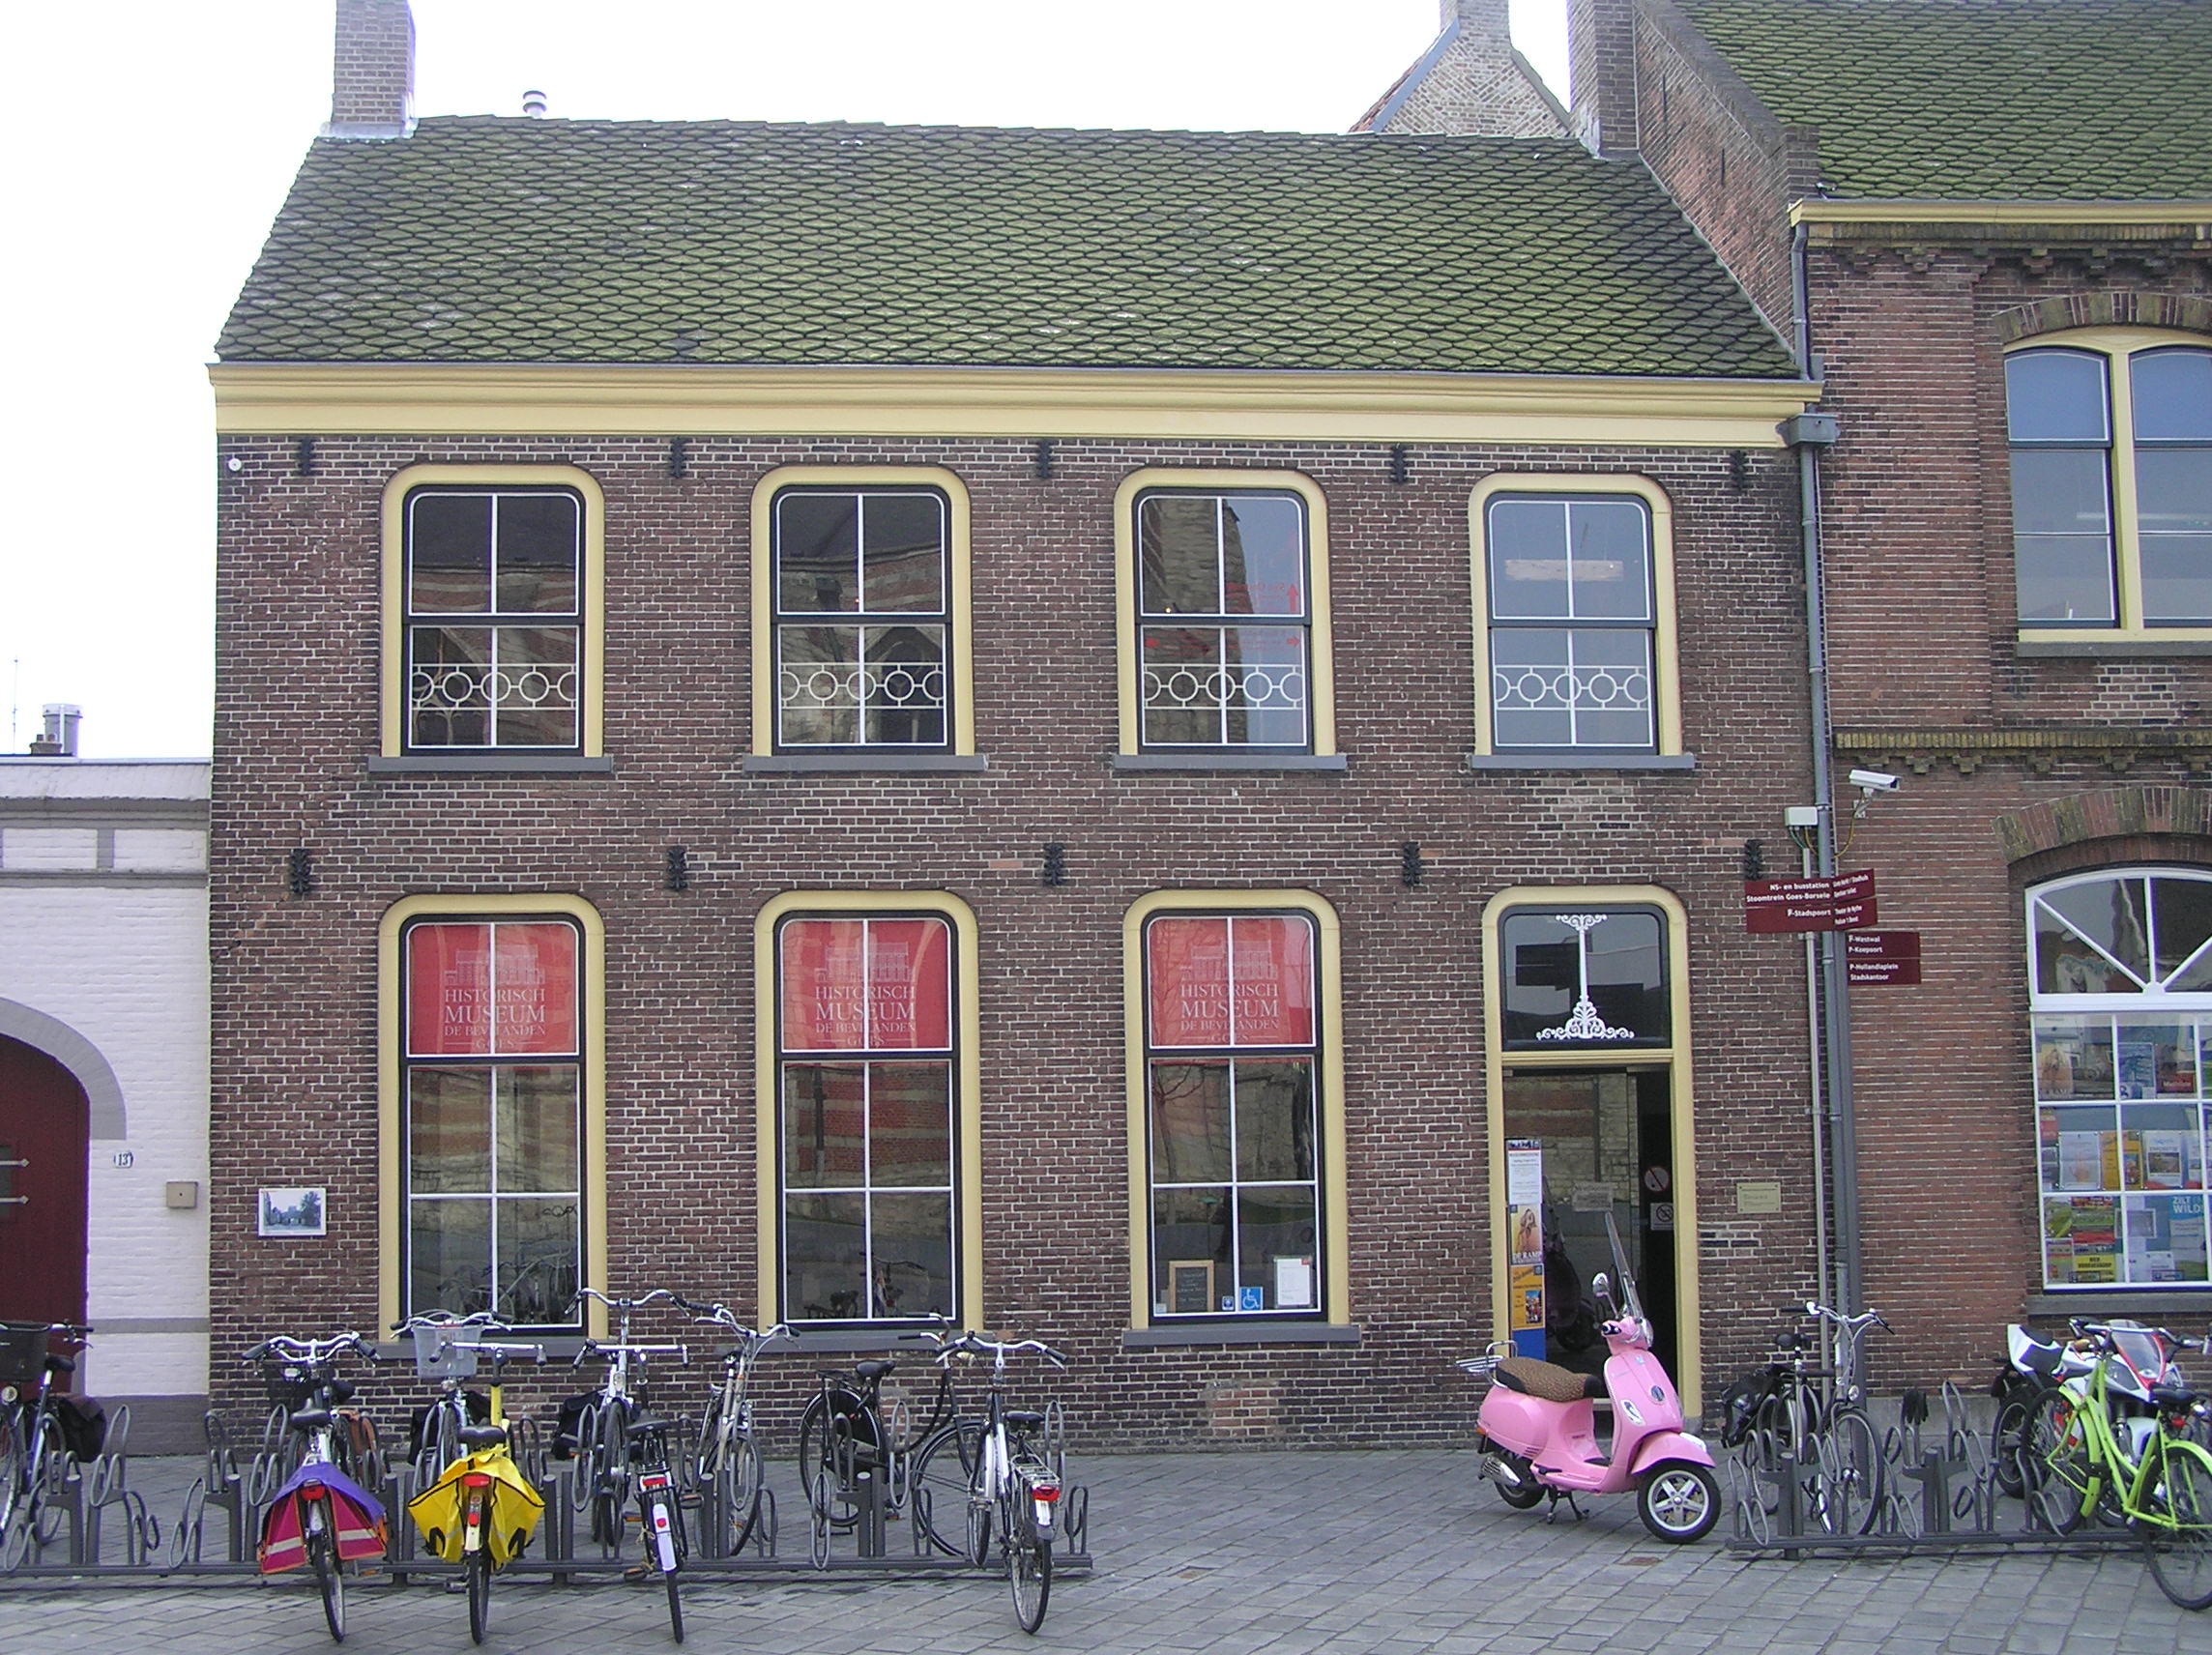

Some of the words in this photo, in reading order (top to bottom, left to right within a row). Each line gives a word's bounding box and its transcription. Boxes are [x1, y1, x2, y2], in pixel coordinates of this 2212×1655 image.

[1793, 881, 1830, 889] busstation
[815, 985, 916, 1000] HISTORISCH
[1180, 983, 1278, 998] HISTORISCH
[445, 1004, 545, 1024] MUSEUM
[816, 1002, 916, 1021] MUSEUM
[1181, 999, 1279, 1018] MUSEUM
[445, 1026, 462, 1036] DE
[465, 1025, 546, 1036] BEVLANDEN
[815, 1023, 832, 1033] DE
[836, 1022, 916, 1033] BEVEANDEN
[1180, 1020, 1196, 1031] DE
[1201, 1019, 1279, 1031] BEVEANDEN
